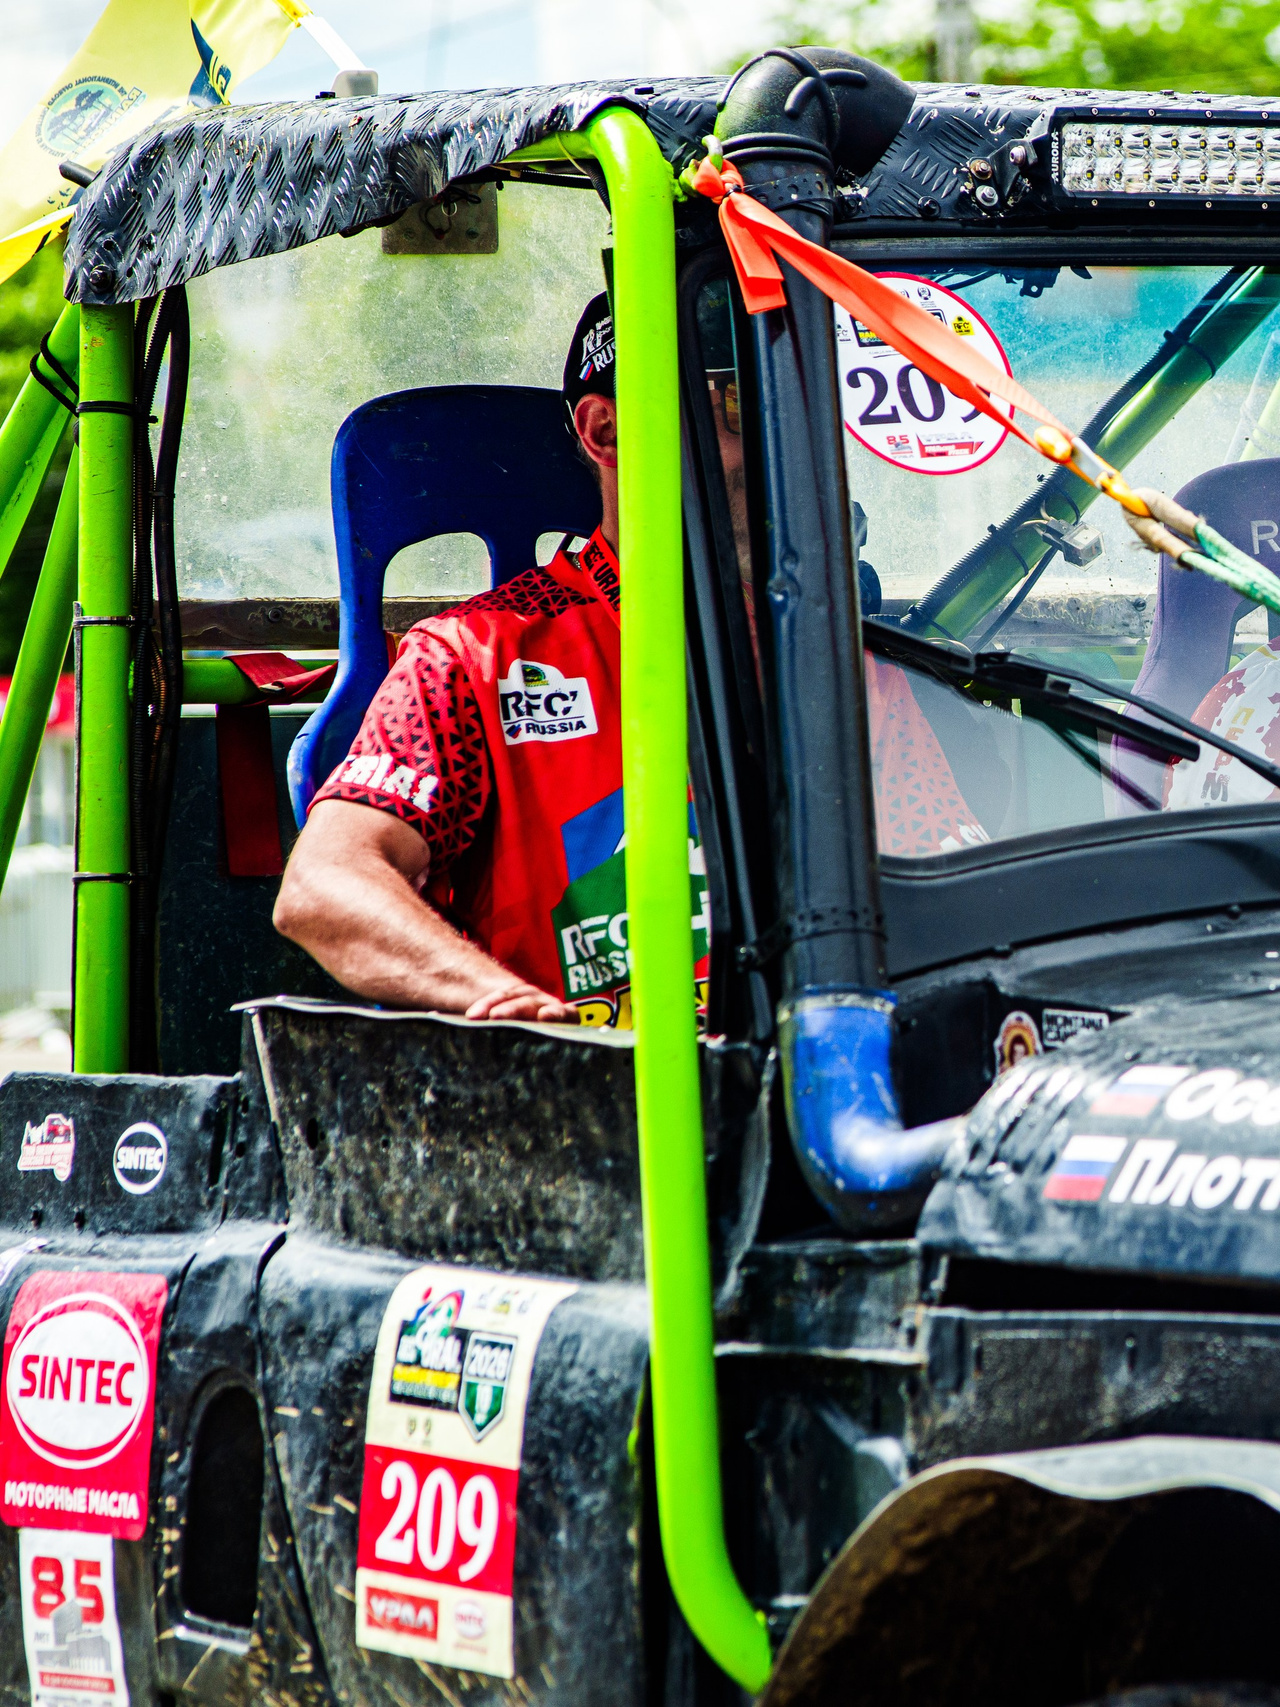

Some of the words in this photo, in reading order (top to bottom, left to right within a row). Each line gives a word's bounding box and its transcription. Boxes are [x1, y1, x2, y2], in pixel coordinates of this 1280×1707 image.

[1050, 129, 1060, 184] AURORA
[886, 435, 910, 445] 85
[500, 690, 579, 721] RFC
[525, 720, 588, 735] RUSSIA
[116, 1146, 163, 1171] SINTEC
[19, 1354, 135, 1407] SINTEC
[4, 1480, 88, 1514] МОТОРНЫЕ
[88, 1488, 140, 1520] МАСЛА
[375, 1460, 499, 1583] 209
[31, 1556, 105, 1624] 85
